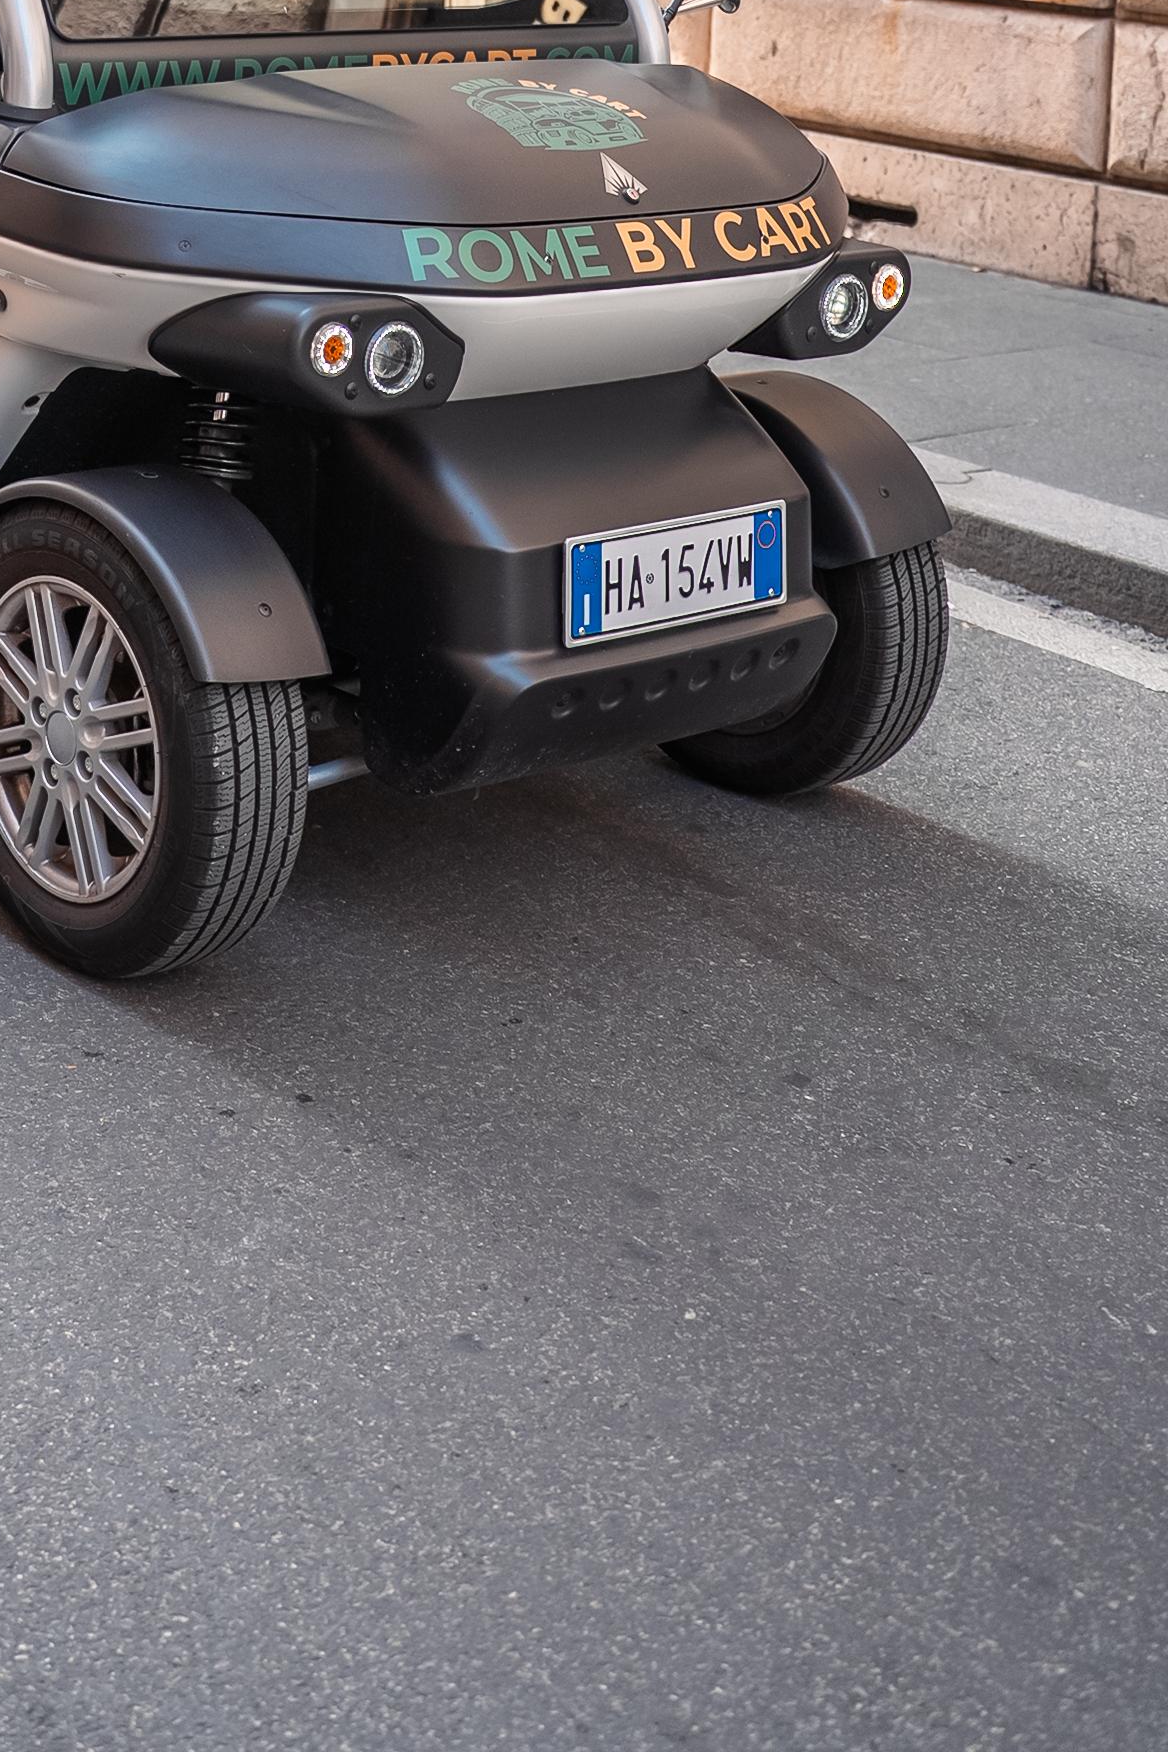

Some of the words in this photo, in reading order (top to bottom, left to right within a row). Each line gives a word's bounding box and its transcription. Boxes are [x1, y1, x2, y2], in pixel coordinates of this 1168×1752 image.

[569, 88, 647, 120] CART
[402, 225, 611, 284] ROME
[615, 217, 697, 274] BY
[713, 196, 832, 263] CART
